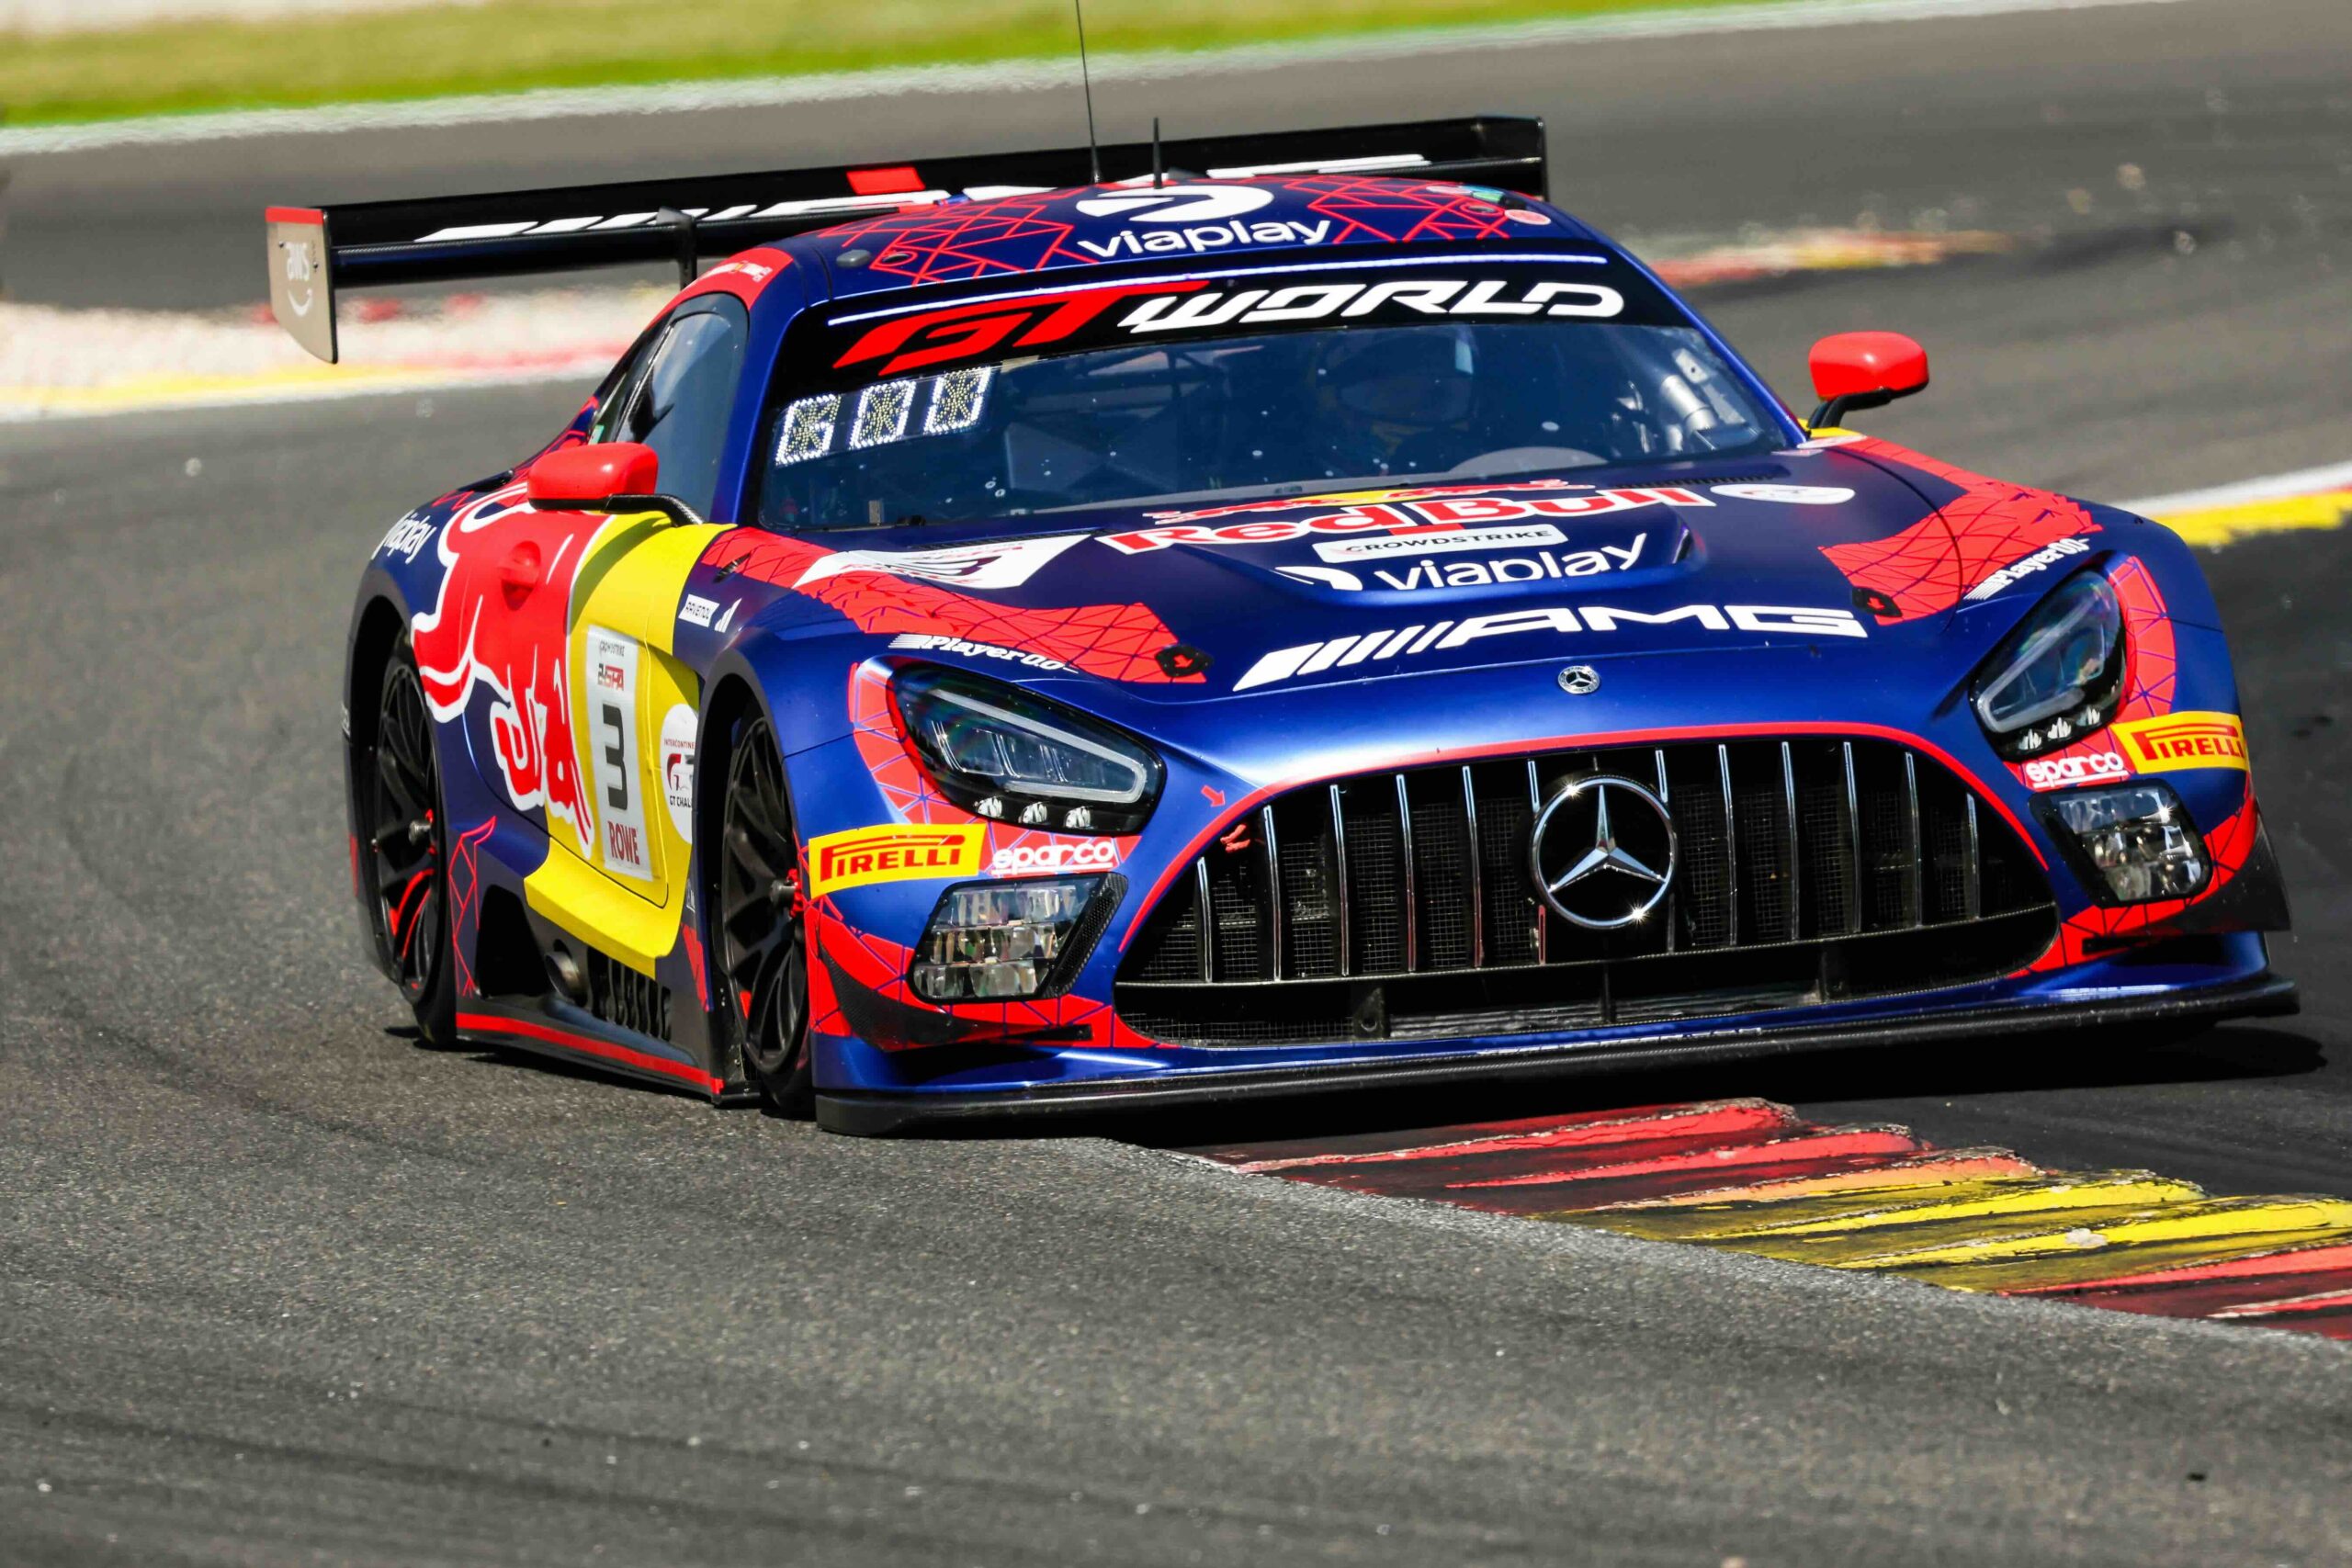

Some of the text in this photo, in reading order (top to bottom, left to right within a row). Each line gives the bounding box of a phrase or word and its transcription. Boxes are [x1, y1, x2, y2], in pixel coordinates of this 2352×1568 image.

[1078, 220, 1330, 258] viaplay
[834, 281, 1624, 378] GT WORLD
[1102, 502, 1418, 555] Red
[1402, 487, 1716, 525] Bull
[1345, 530, 1553, 552] CROWDSTRIKE
[1373, 532, 1646, 591] viaplay
[603, 704, 628, 810] 3
[2131, 723, 2245, 761] PIRELLI
[2025, 751, 2125, 788] sparco
[607, 820, 640, 865] ROWE
[820, 834, 966, 882] PIRELLI
[991, 840, 1115, 877] sparco
